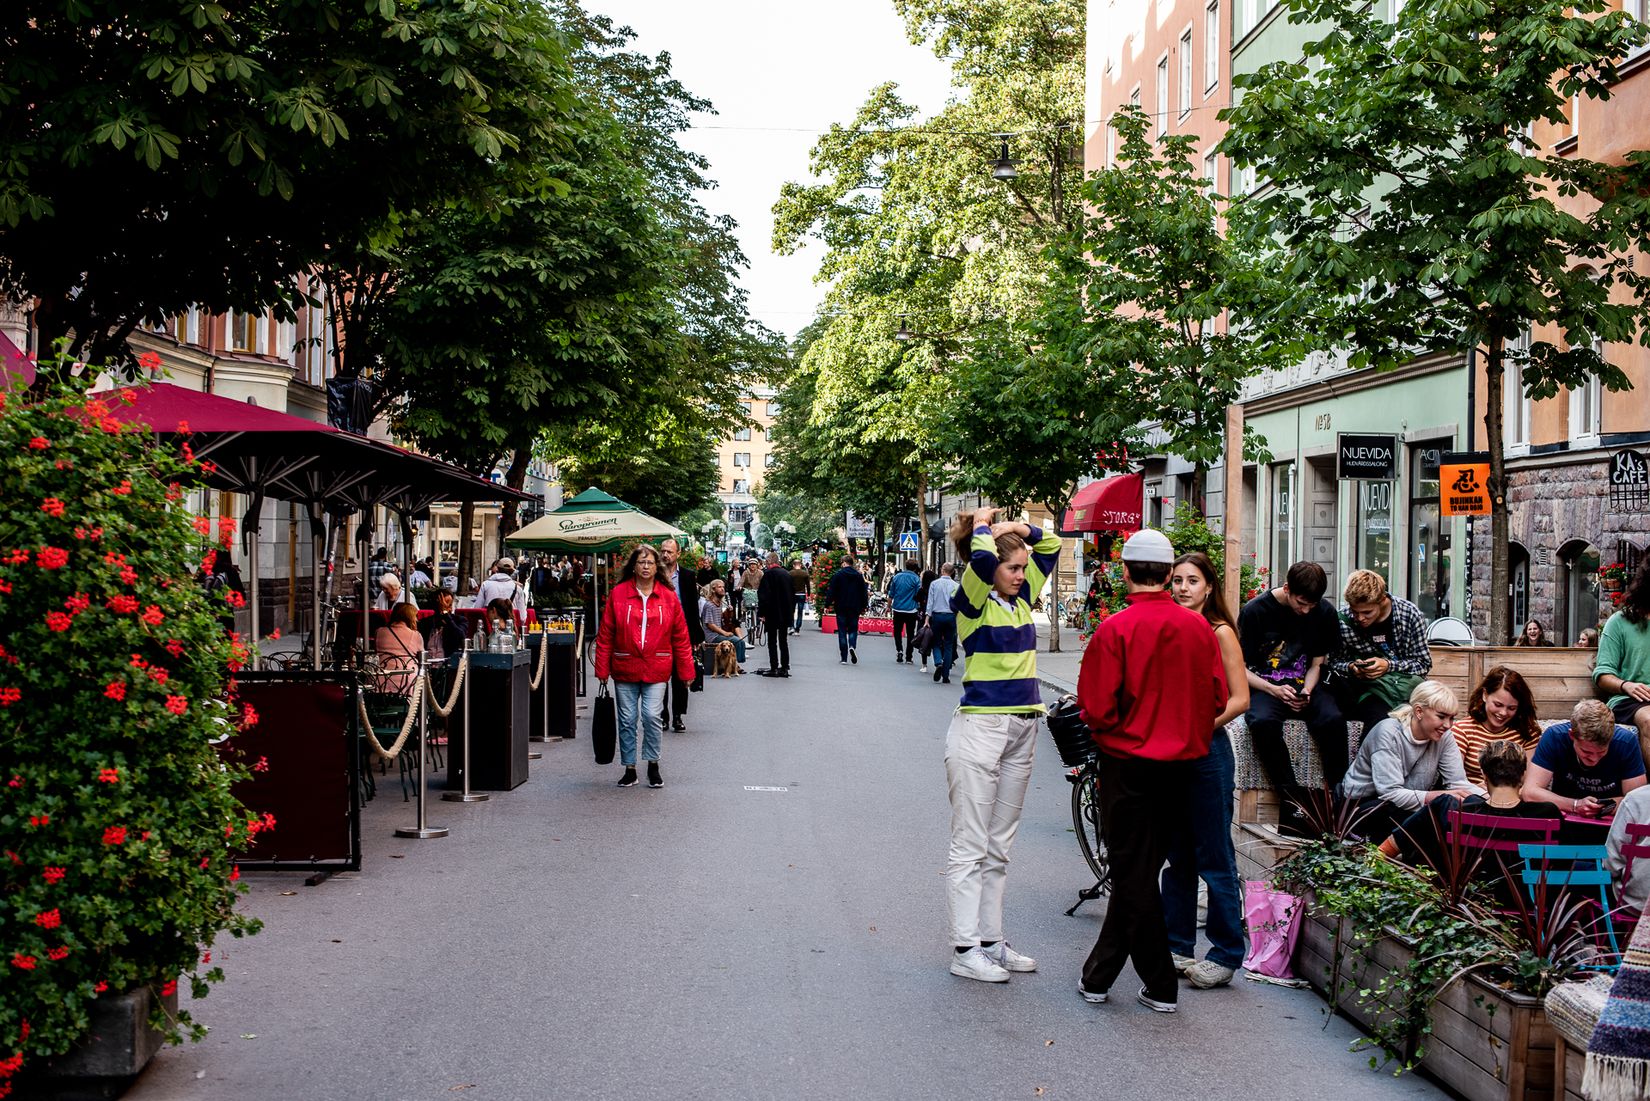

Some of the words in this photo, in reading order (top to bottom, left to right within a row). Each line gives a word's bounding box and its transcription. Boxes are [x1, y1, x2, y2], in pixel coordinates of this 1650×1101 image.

[1342, 447, 1392, 459] NUEVIDA
[1612, 470, 1647, 484] CAFE
[558, 518, 618, 533] Staropramen
